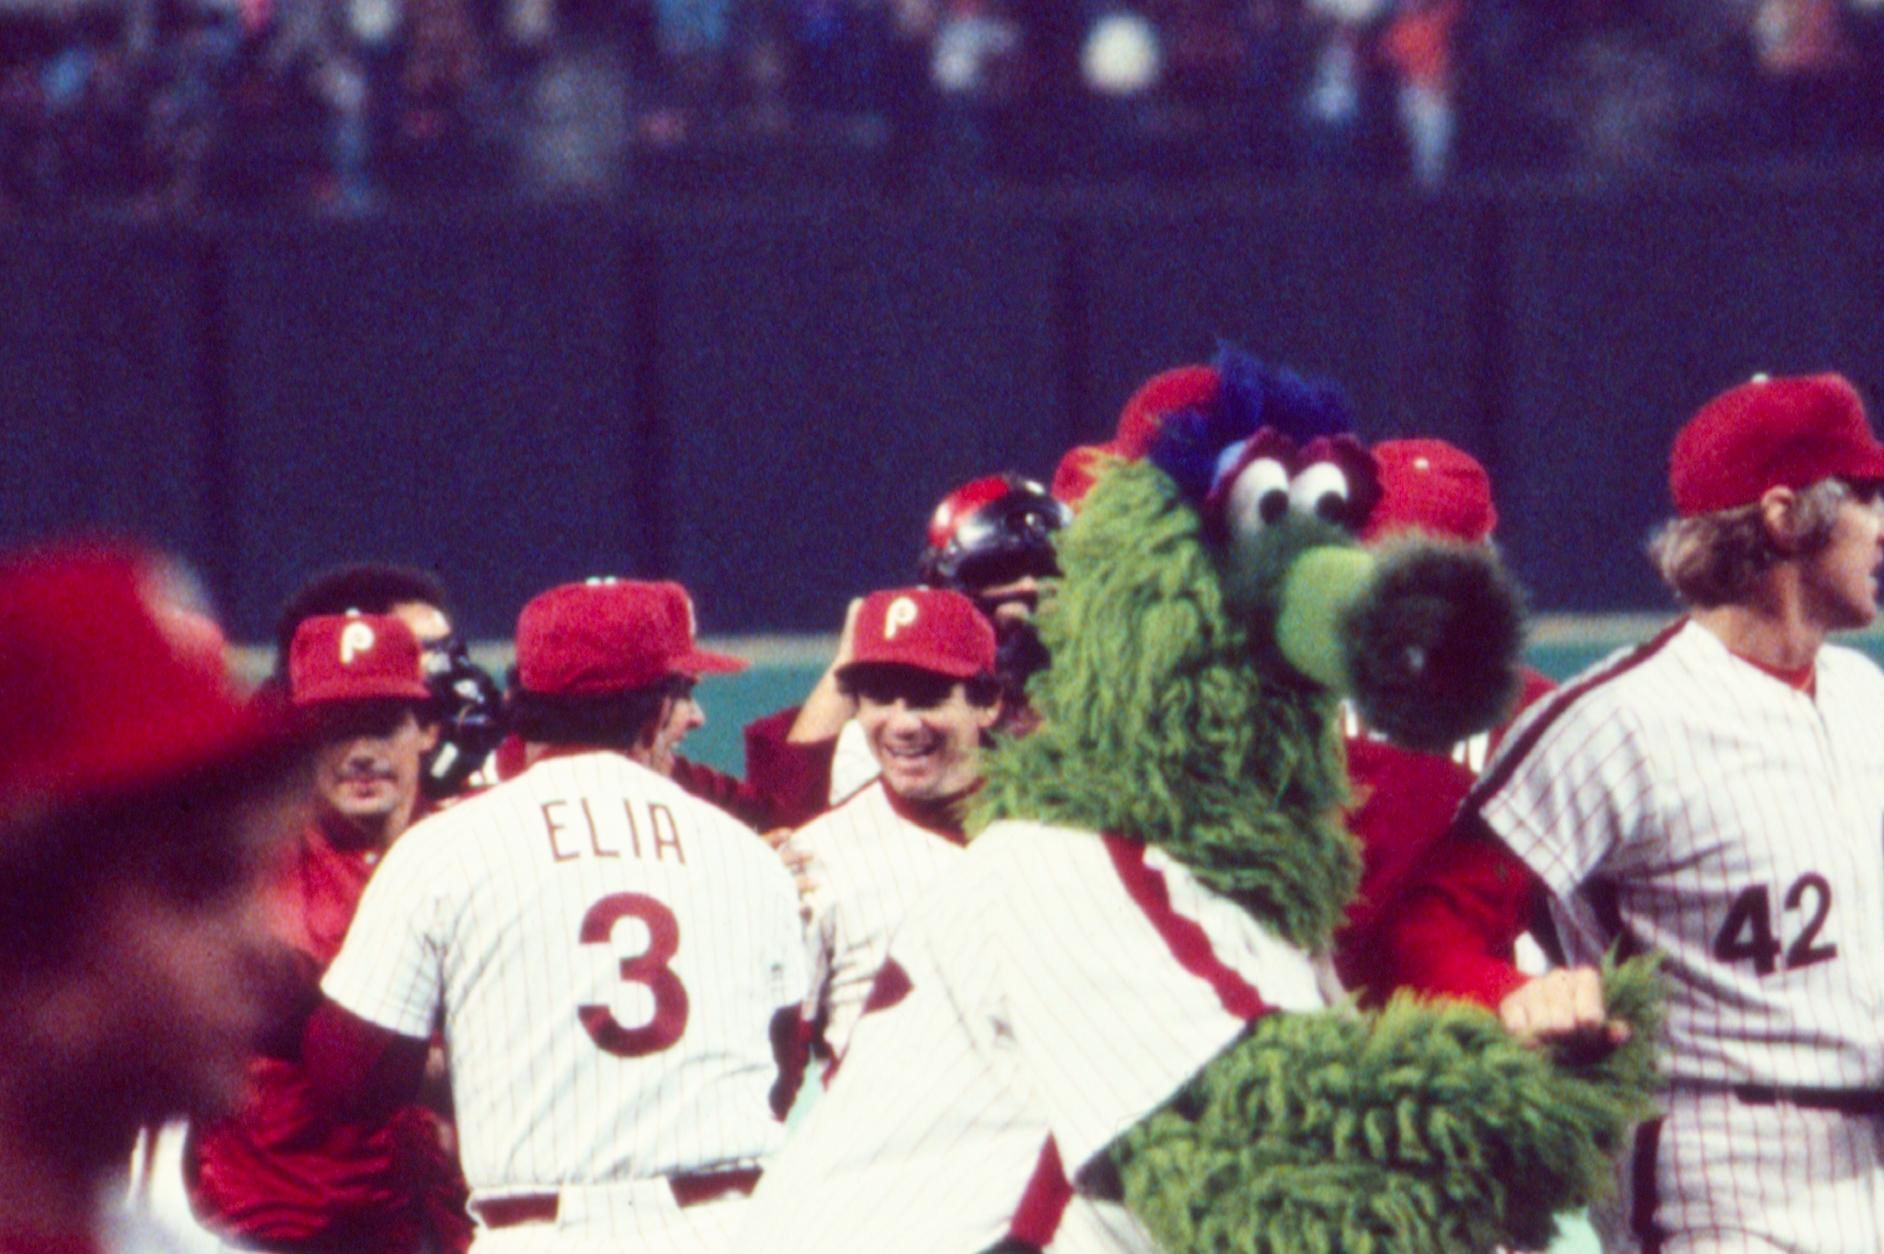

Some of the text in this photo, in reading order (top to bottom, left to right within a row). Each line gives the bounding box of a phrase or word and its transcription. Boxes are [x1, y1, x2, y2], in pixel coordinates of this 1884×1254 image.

[340, 621, 376, 665] P
[884, 596, 918, 641] P
[540, 797, 686, 866] ELIA
[1713, 870, 1838, 977] 42
[577, 891, 690, 1059] 3
